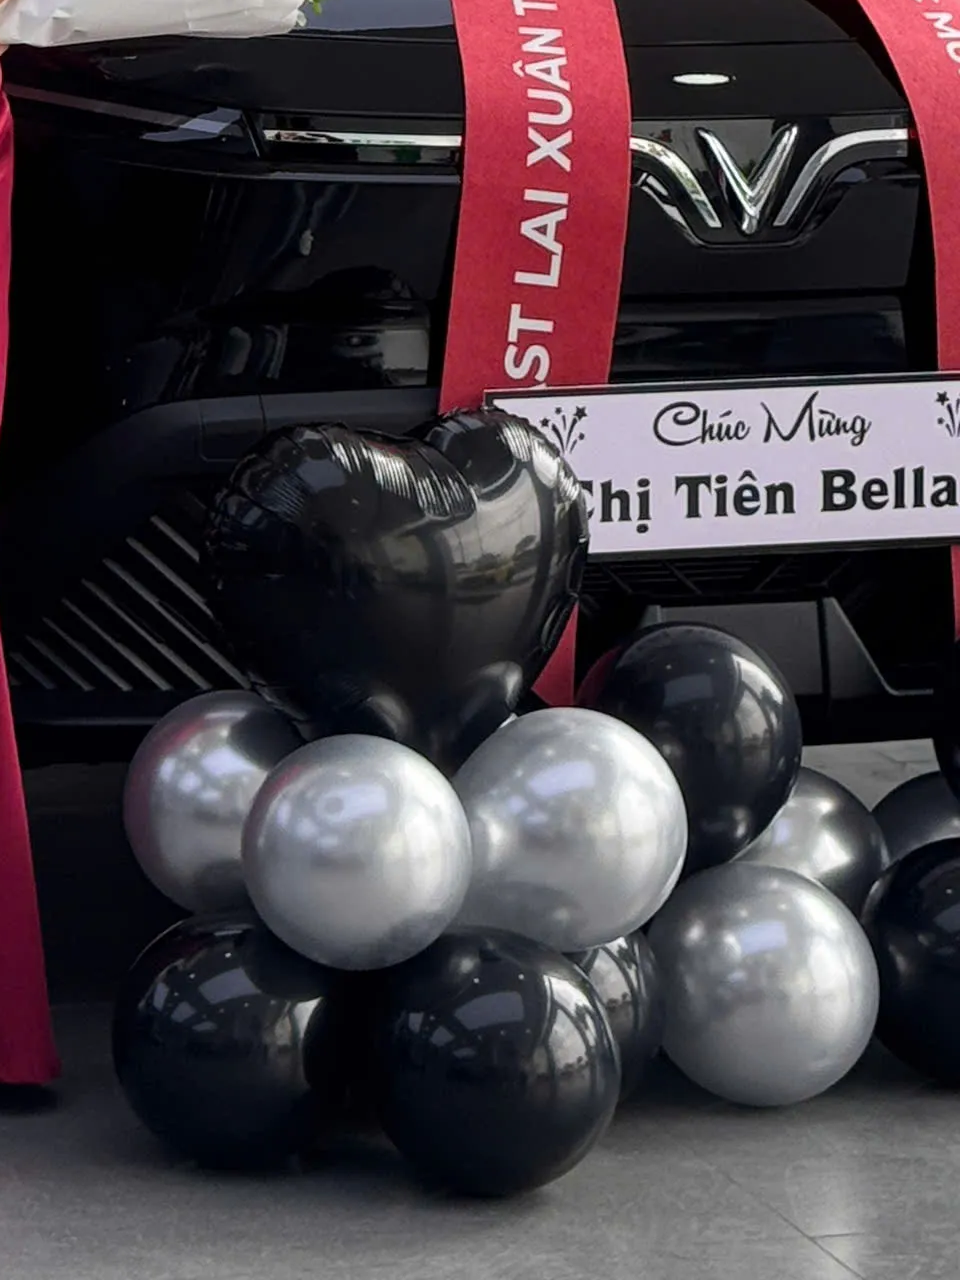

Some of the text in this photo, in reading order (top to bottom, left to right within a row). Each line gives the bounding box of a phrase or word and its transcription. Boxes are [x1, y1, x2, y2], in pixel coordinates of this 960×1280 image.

[513, 26, 575, 172] XUÂN
[514, 189, 569, 288] LAI
[504, 303, 555, 389] ST
[653, 401, 751, 446] Chúc
[674, 470, 796, 519] Tiên
[820, 465, 958, 513] Bella
